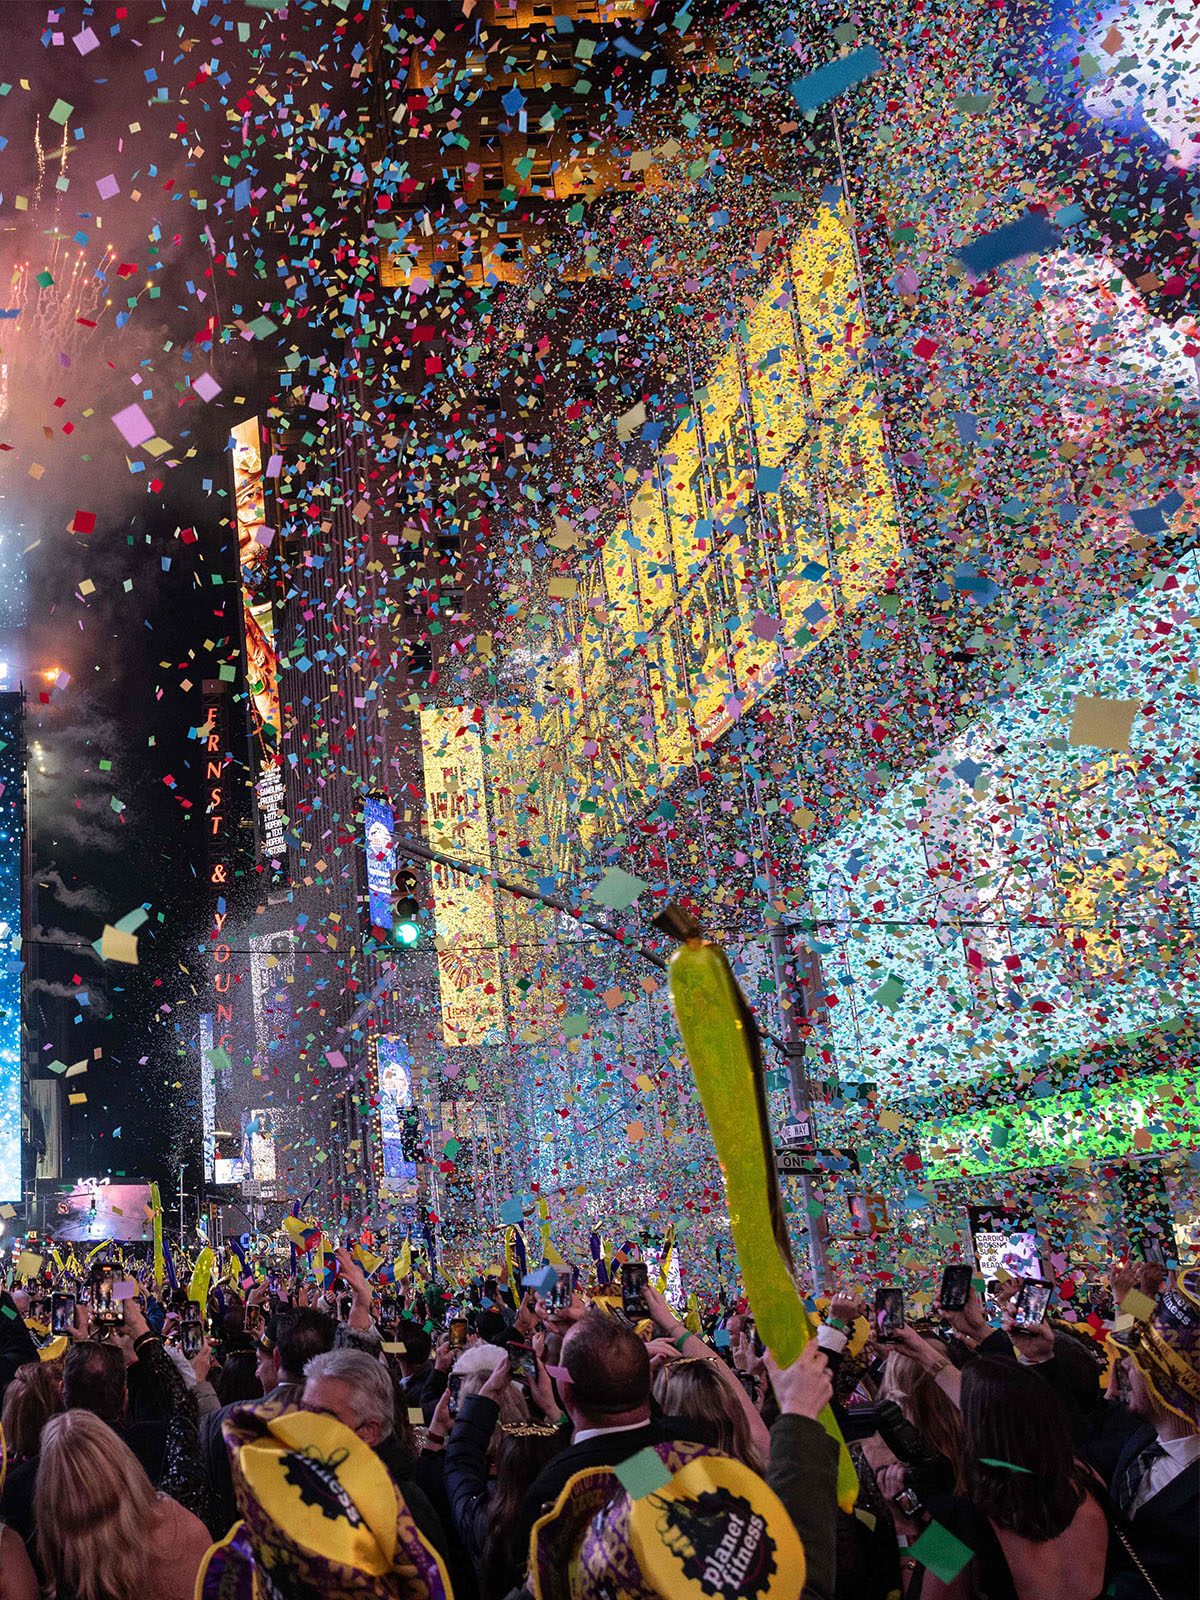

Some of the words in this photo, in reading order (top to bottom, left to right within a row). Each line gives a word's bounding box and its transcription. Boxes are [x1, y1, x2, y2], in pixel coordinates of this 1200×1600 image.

[207, 708, 223, 834] ERNST
[260, 783, 283, 796] GAMBLING
[260, 792, 284, 804] PROBLEM?
[266, 802, 279, 812] CALL
[271, 827, 283, 837] TEXT
[211, 864, 227, 883] &
[795, 1124, 807, 1135] WAY
[703, 1512, 745, 1590] planet
[721, 1514, 764, 1590] fitness
